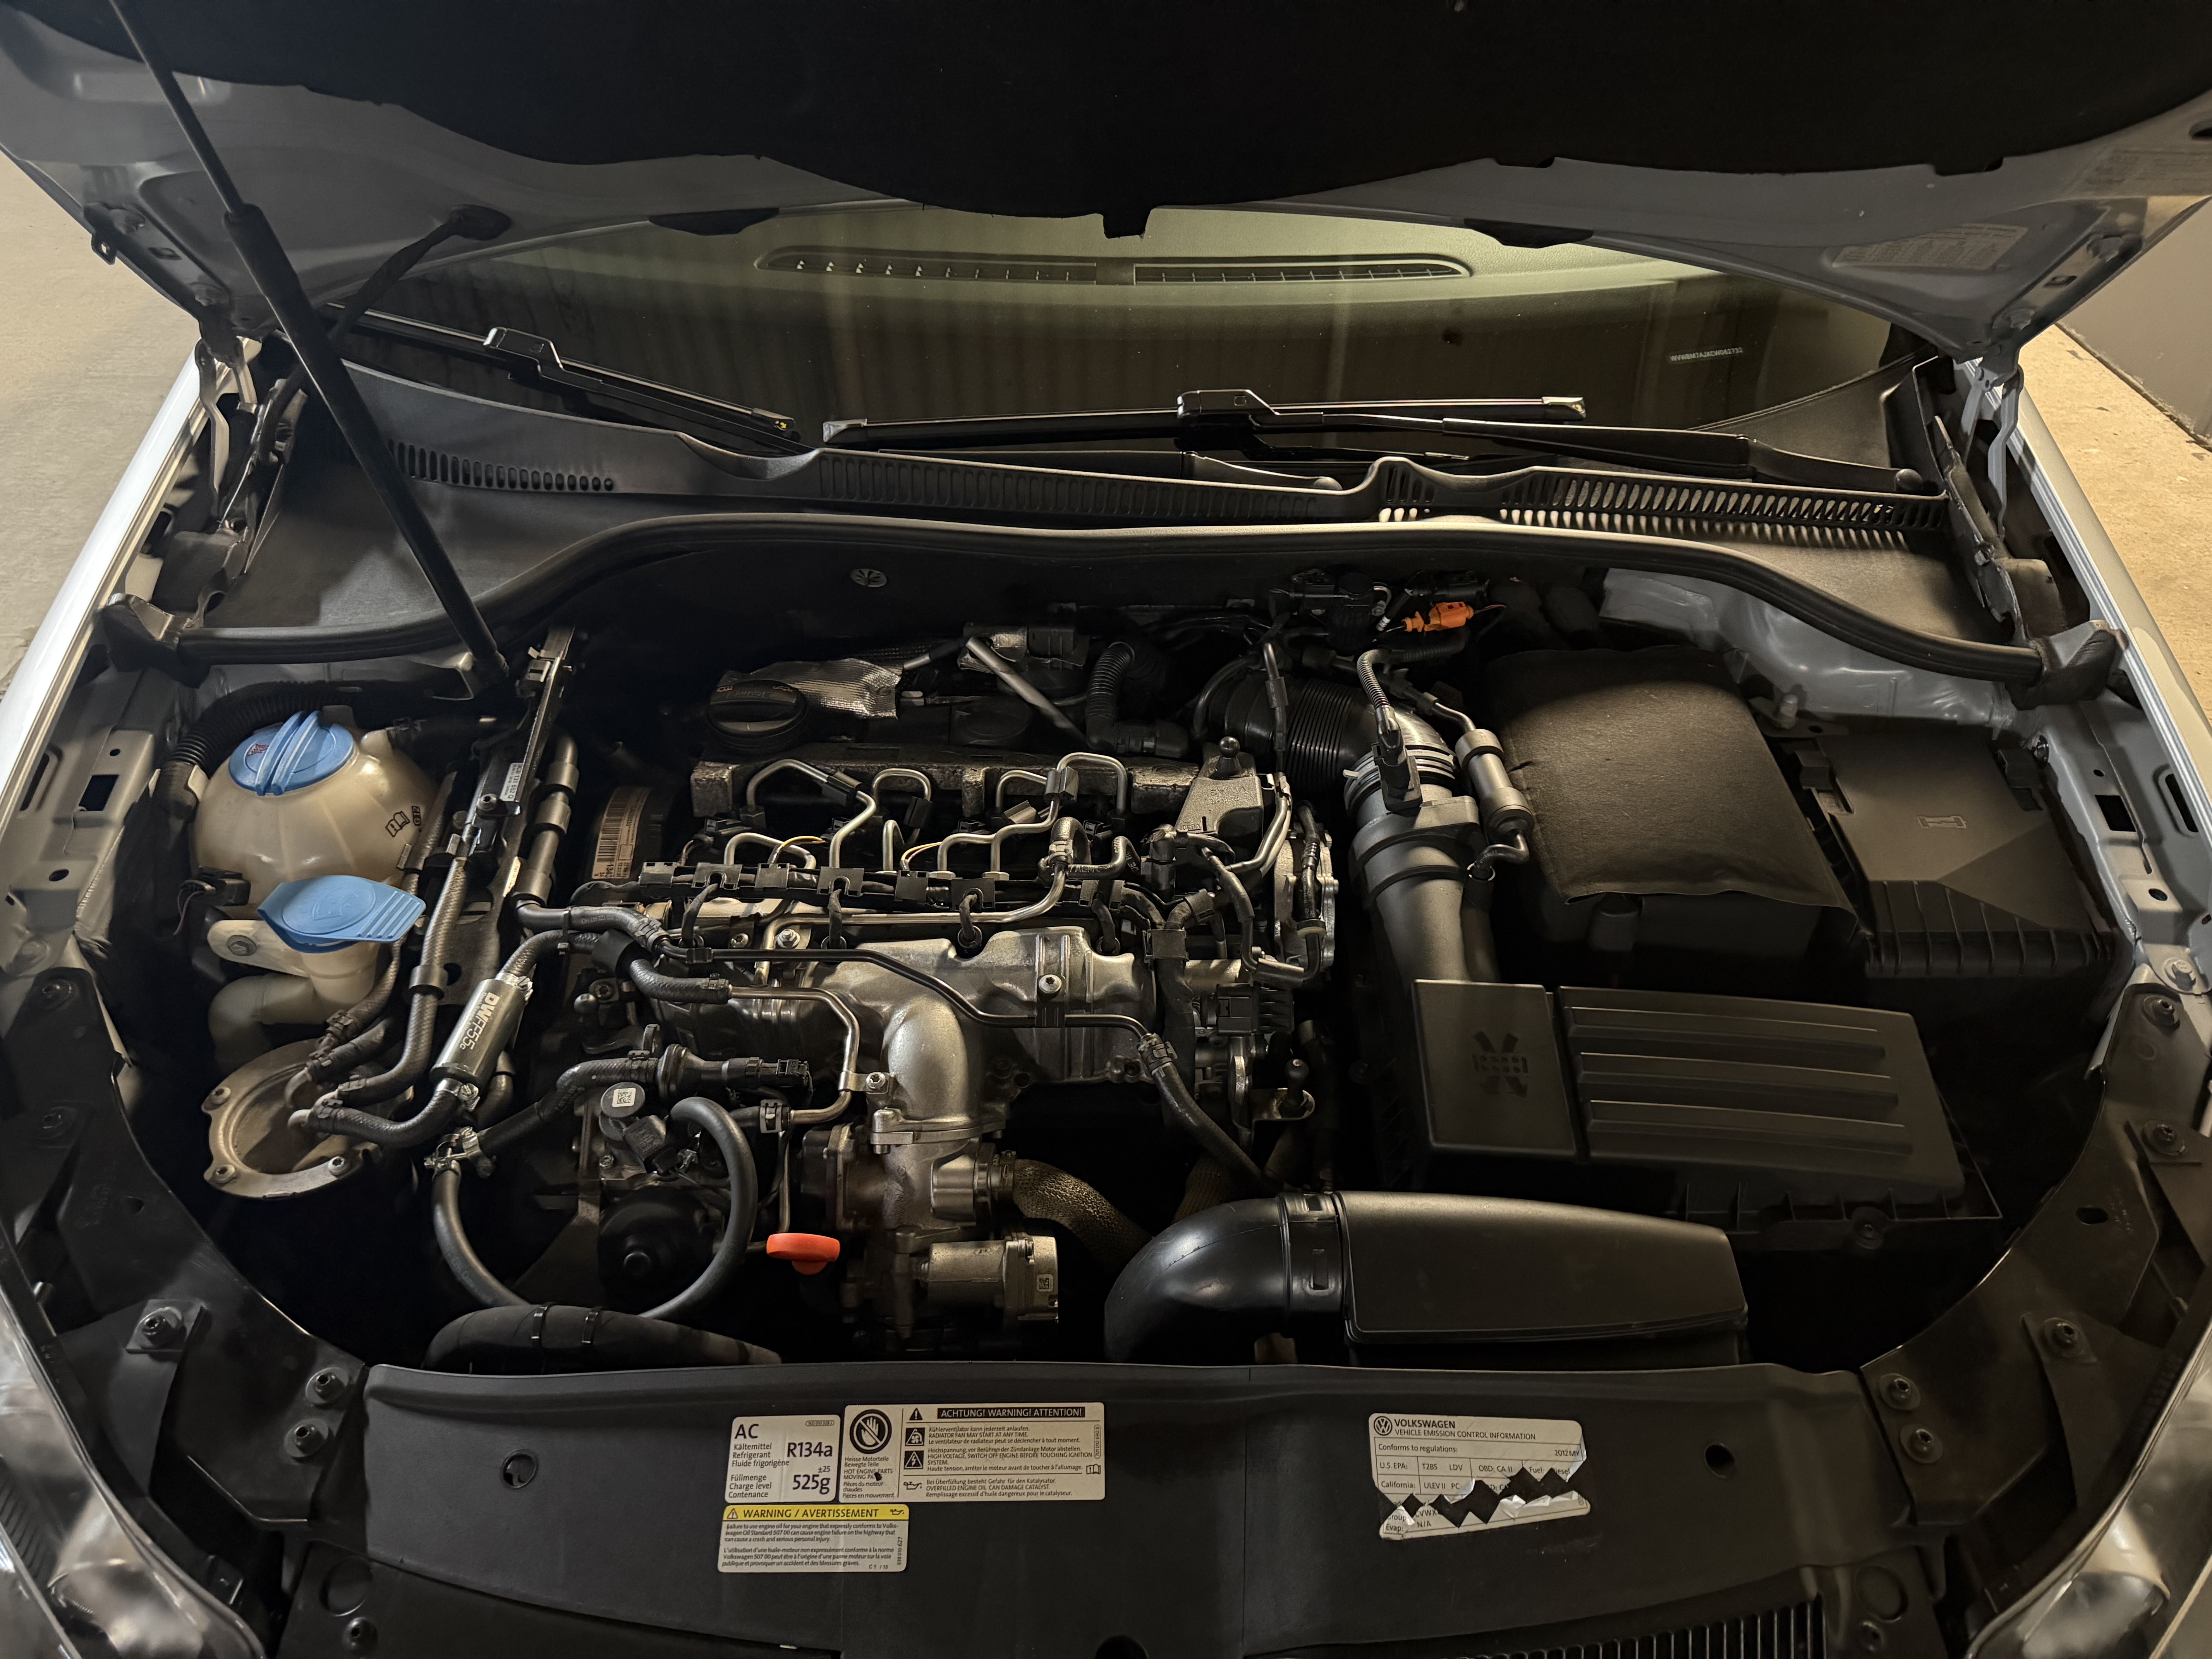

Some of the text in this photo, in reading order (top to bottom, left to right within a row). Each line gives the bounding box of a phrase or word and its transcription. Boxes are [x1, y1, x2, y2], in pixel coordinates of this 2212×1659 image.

[941, 1408, 1082, 1417] ACHTUNG! WARNING! ATTENTION!
[1394, 1419, 1455, 1429] VOLKSWAGEN
[735, 1424, 759, 1439] AC
[787, 1442, 833, 1457] R134a
[733, 1451, 771, 1461] Refrigerant
[753, 1459, 790, 1468] frigorigène
[731, 1474, 767, 1482] Füllmenge
[729, 1483, 754, 1491] Charge
[793, 1474, 831, 1495] 525g
[744, 1509, 879, 1518] WARNING / AVERTISSEMENT
[1386, 1523, 1403, 1533] Evap:
